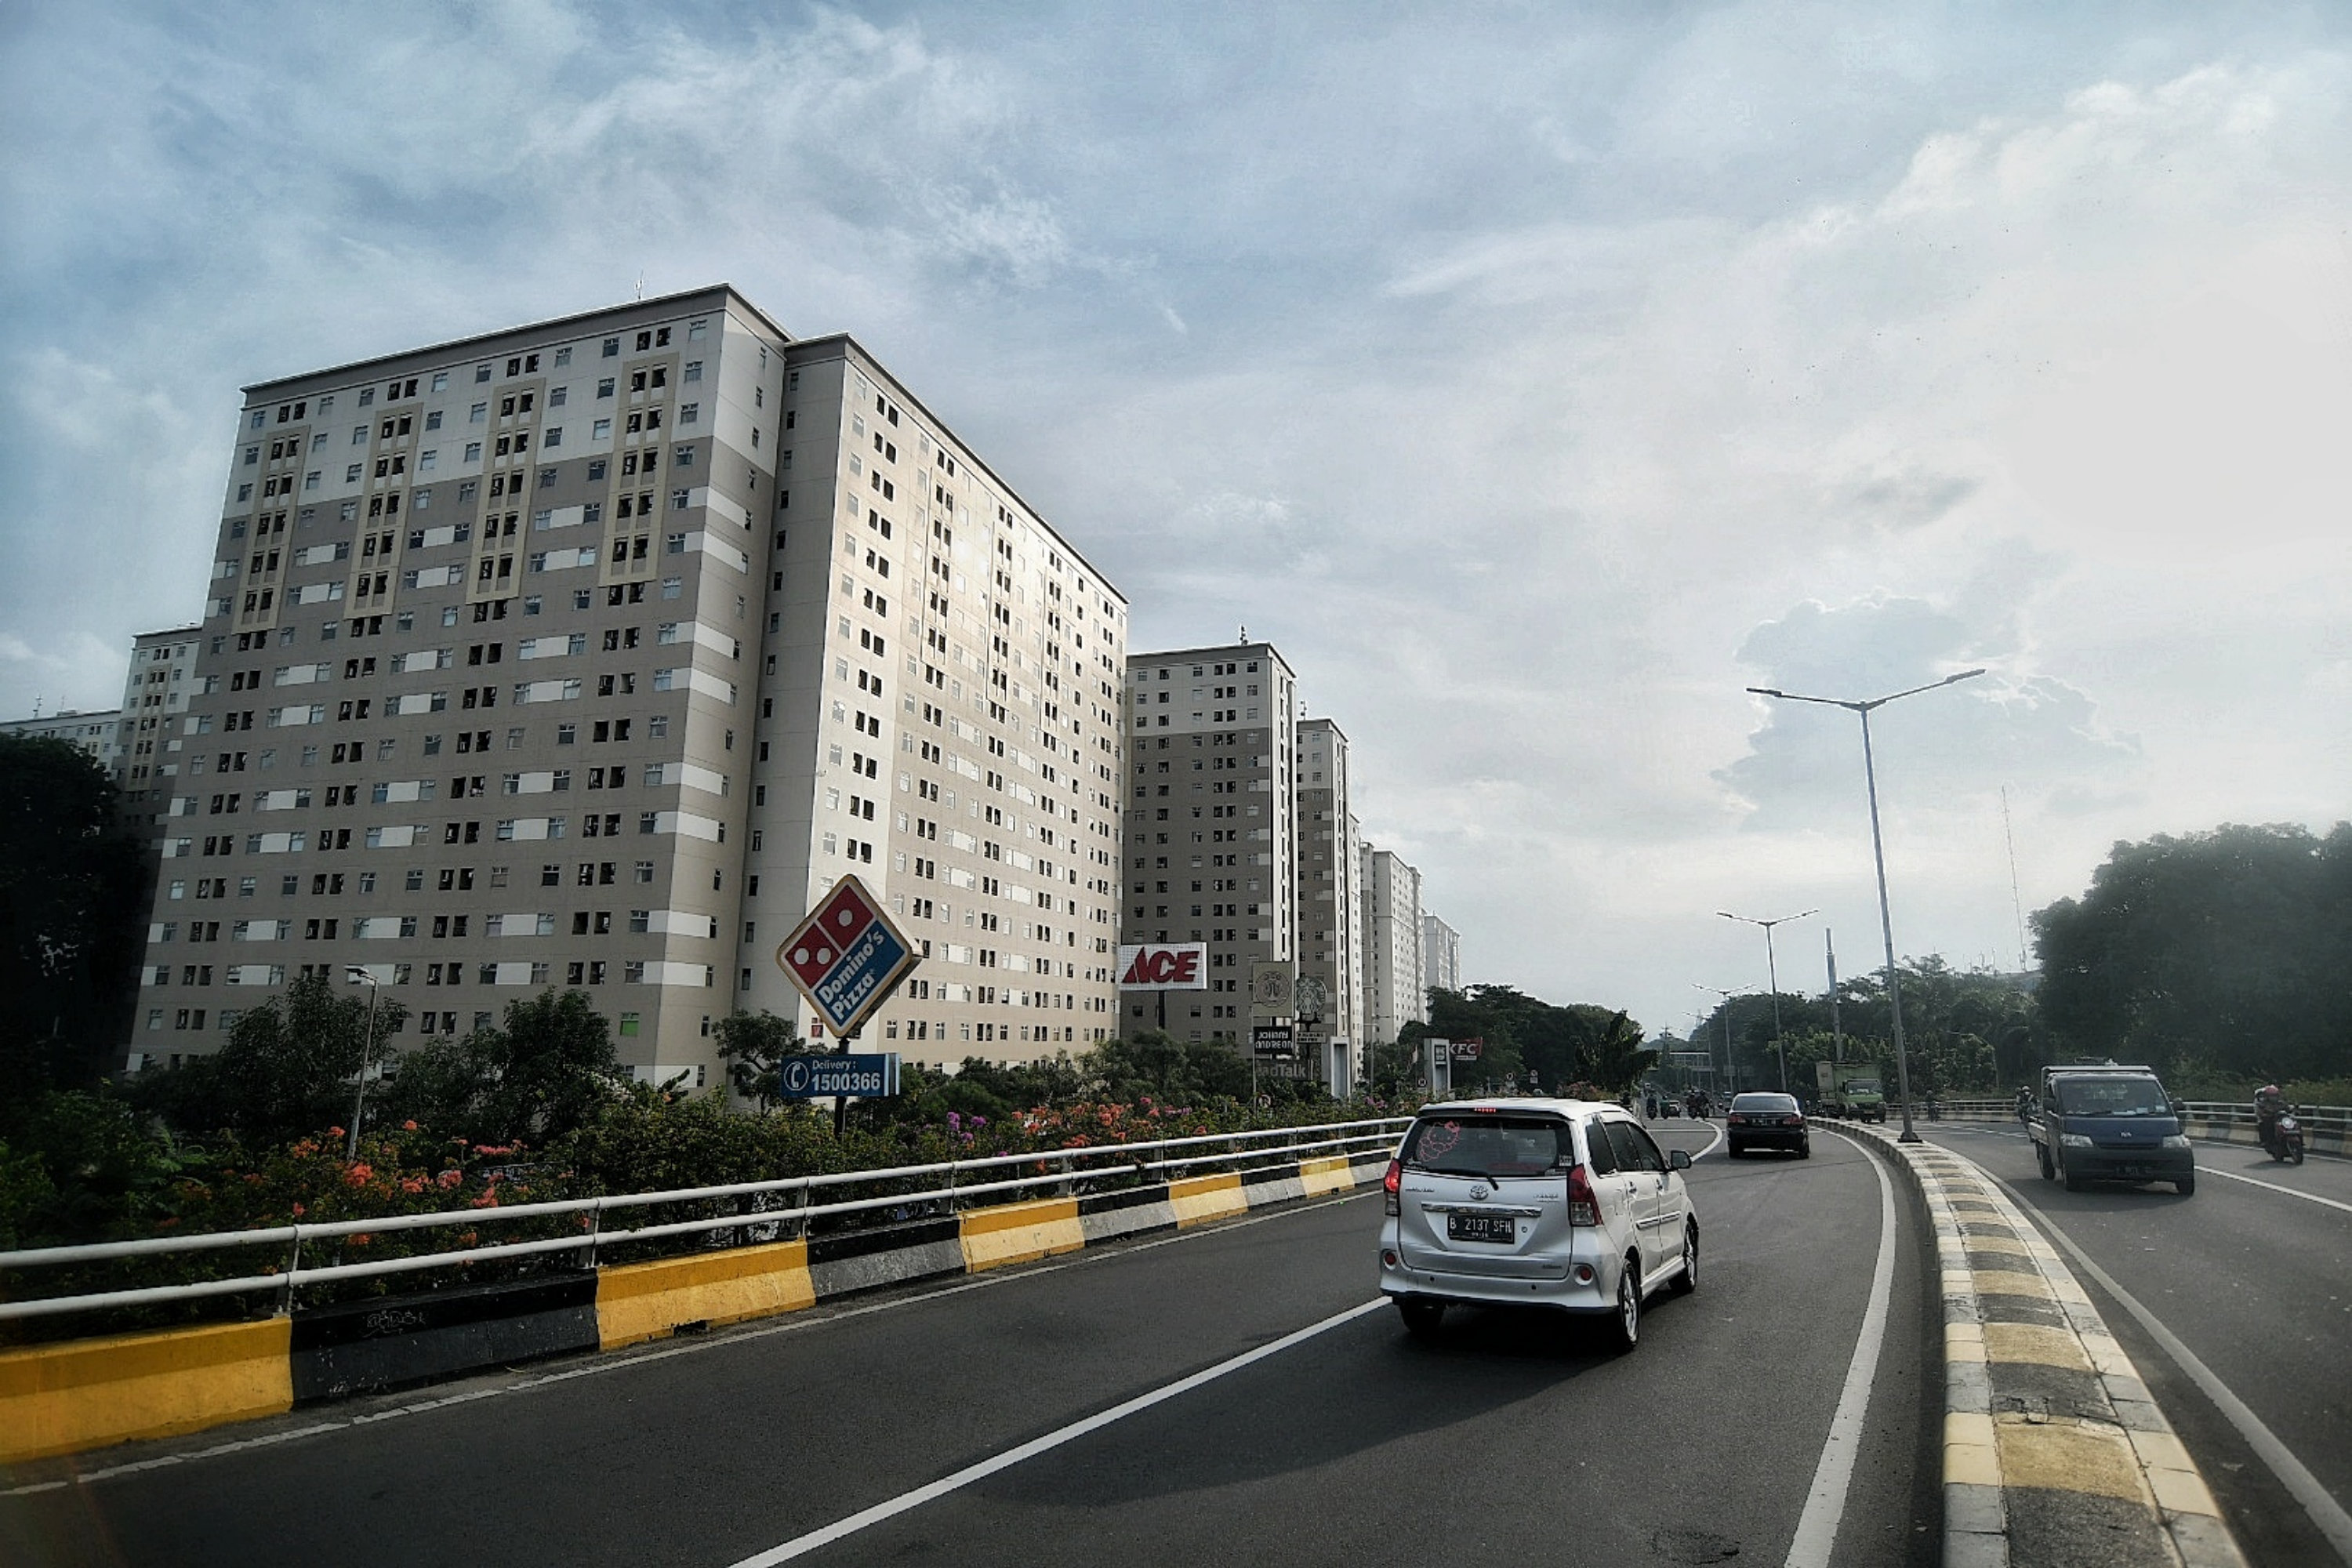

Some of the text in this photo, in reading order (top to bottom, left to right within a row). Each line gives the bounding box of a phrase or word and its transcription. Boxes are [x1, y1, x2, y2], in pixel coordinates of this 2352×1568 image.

[818, 930, 884, 1004] Domino's
[1121, 946, 1200, 984] ACE
[831, 974, 875, 1020] Pizza
[1450, 1044, 1477, 1054] KFC
[811, 1073, 880, 1091] 1500366
[1450, 1217, 1457, 1229] B
[1465, 1218, 1489, 1232] 2137
